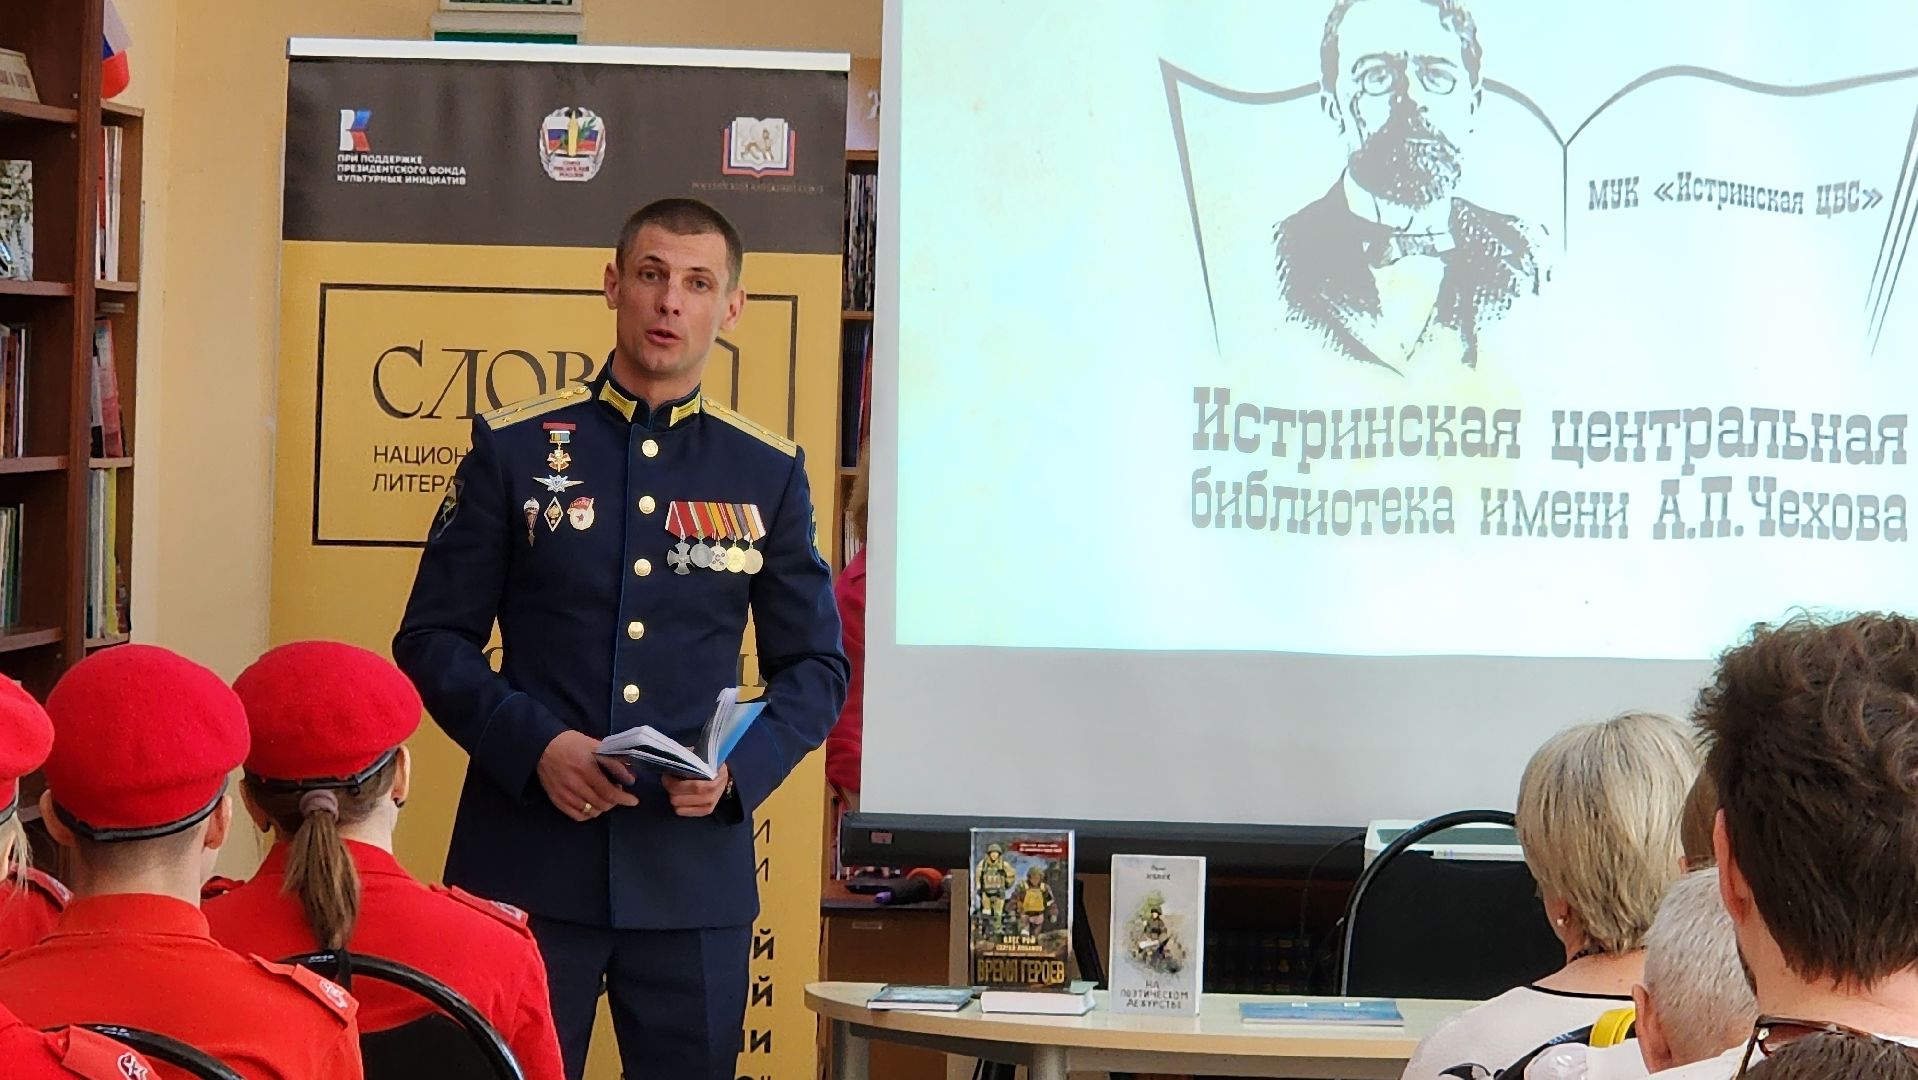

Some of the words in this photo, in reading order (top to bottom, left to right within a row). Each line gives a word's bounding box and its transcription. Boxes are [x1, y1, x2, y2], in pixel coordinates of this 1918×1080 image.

[337, 153, 359, 163] ПРИ
[360, 154, 423, 165] ПОДДЕРЖКЕ
[337, 163, 427, 175] ПРЕЗИДЕНТСКОГО
[428, 166, 467, 176] ФОНДА
[337, 174, 403, 184] КУЛЬТУРНЫХ
[404, 175, 467, 186] ИНИЦИАТИВ
[1588, 175, 1640, 211] МУК
[1653, 170, 1805, 216] «Истринская
[1815, 179, 1884, 220] ЦБС»
[1192, 386, 1522, 474] Истринская
[1551, 405, 1908, 476] центральная
[1191, 466, 1455, 536] библиотека
[1480, 487, 1630, 539] имени
[1652, 475, 1908, 542] А.П.Чехова
